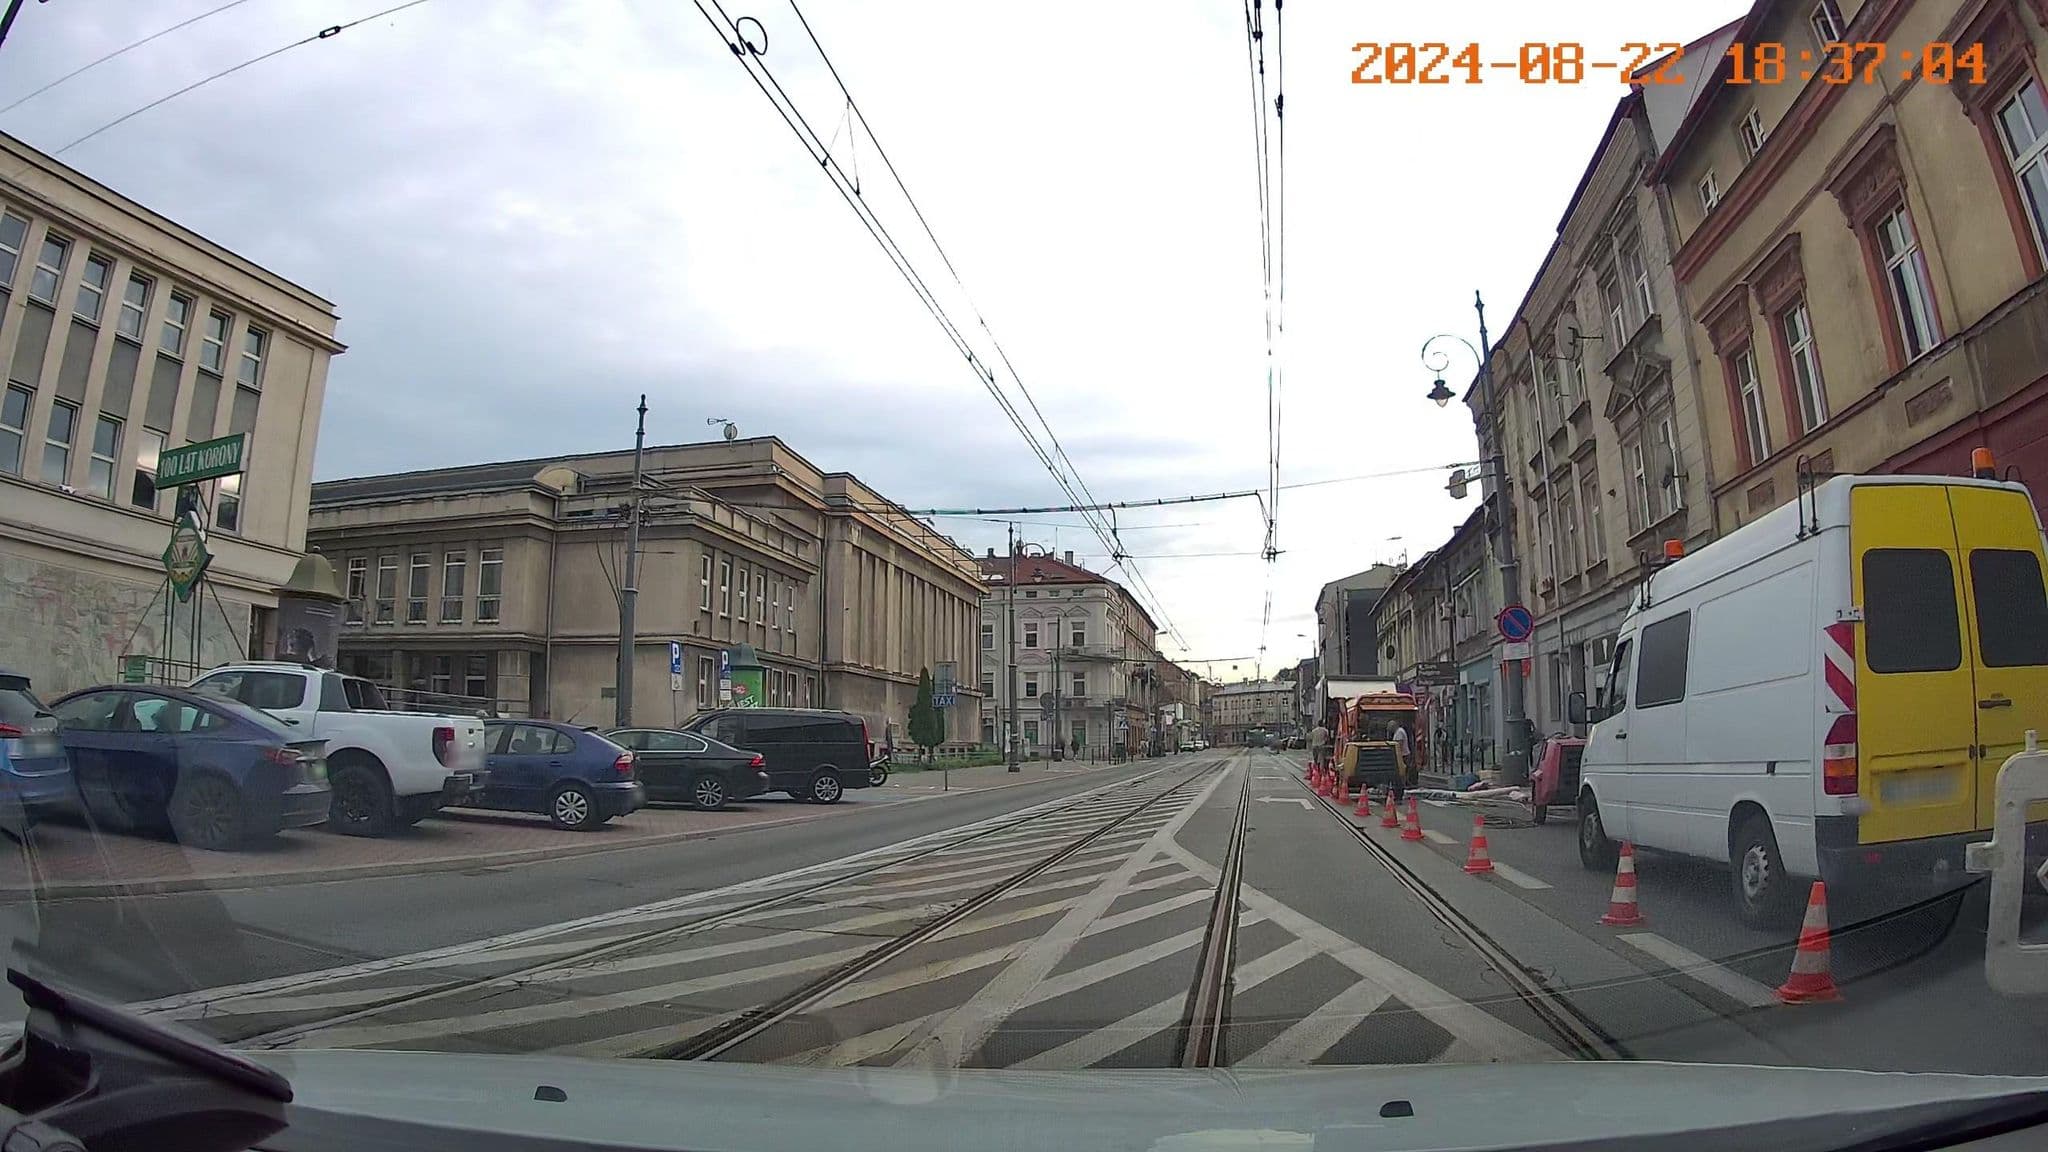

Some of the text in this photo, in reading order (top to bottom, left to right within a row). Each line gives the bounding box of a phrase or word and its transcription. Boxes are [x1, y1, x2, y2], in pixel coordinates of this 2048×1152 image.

[160, 442, 240, 478] 100 LAT KORONY
[672, 643, 680, 665] P
[721, 650, 729, 670] P
[933, 695, 955, 706] TAXI
